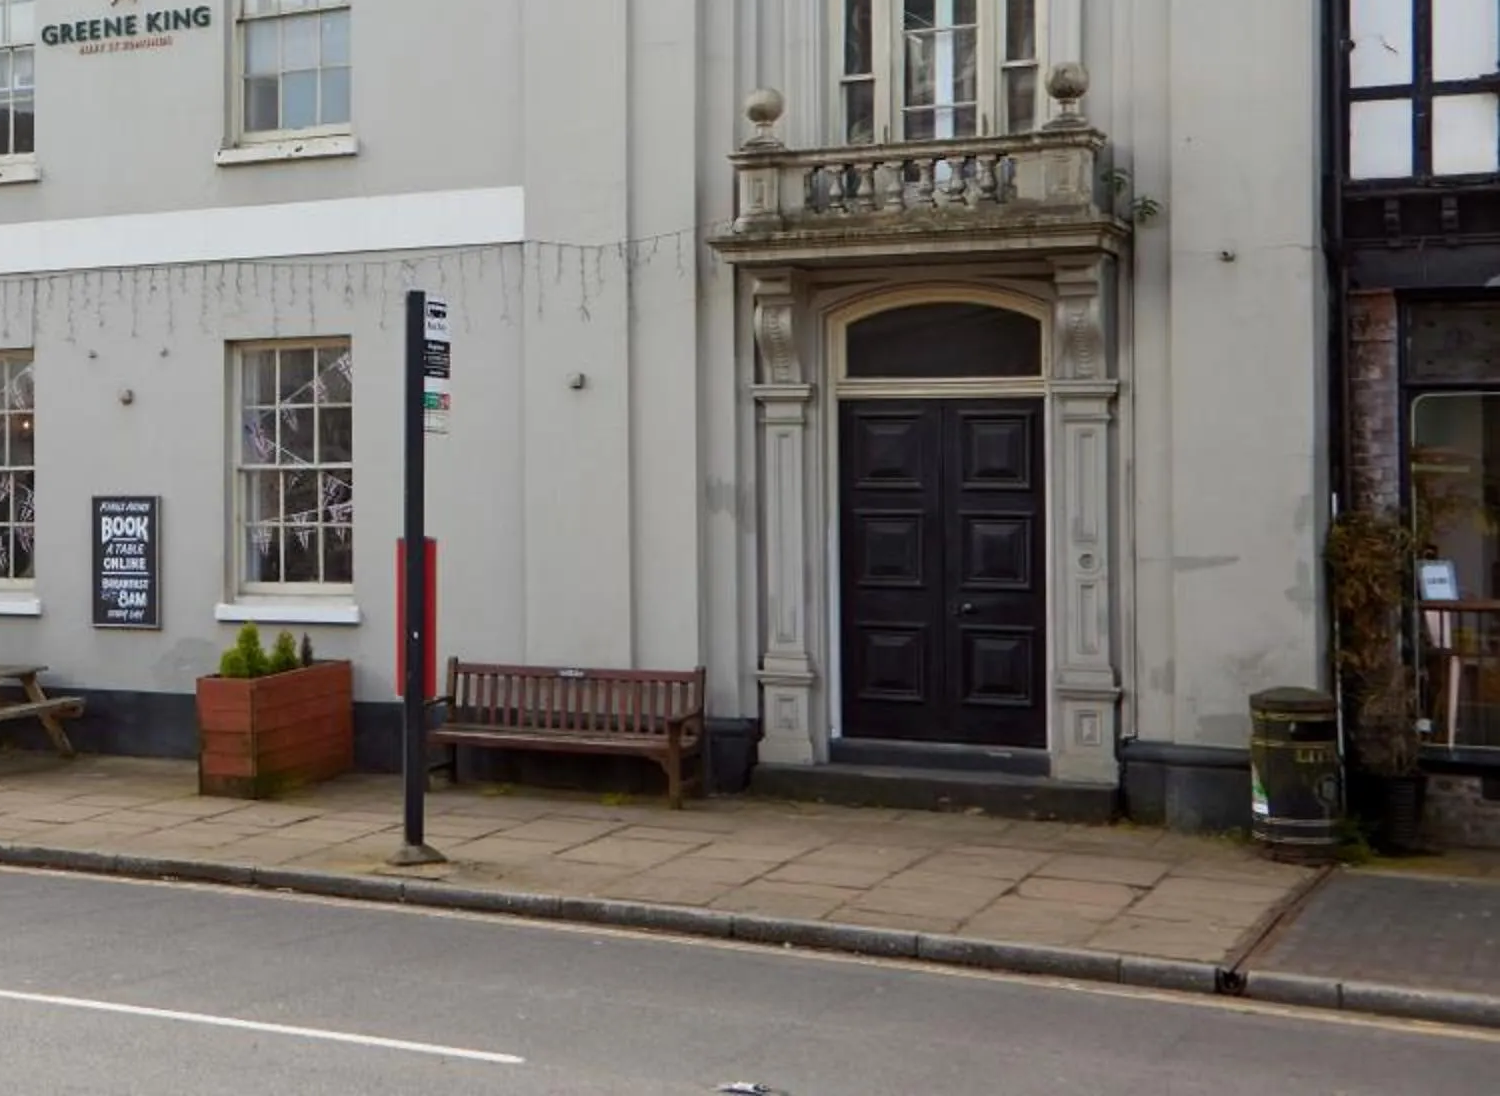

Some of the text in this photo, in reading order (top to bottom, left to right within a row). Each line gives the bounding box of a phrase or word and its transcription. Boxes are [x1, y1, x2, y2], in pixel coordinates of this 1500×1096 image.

[41, 5, 211, 46] GREENE KING
[101, 516, 149, 544] BOOK
[115, 544, 145, 555] TABLE
[103, 557, 147, 571] ONLINE
[117, 589, 148, 608] 8AM
